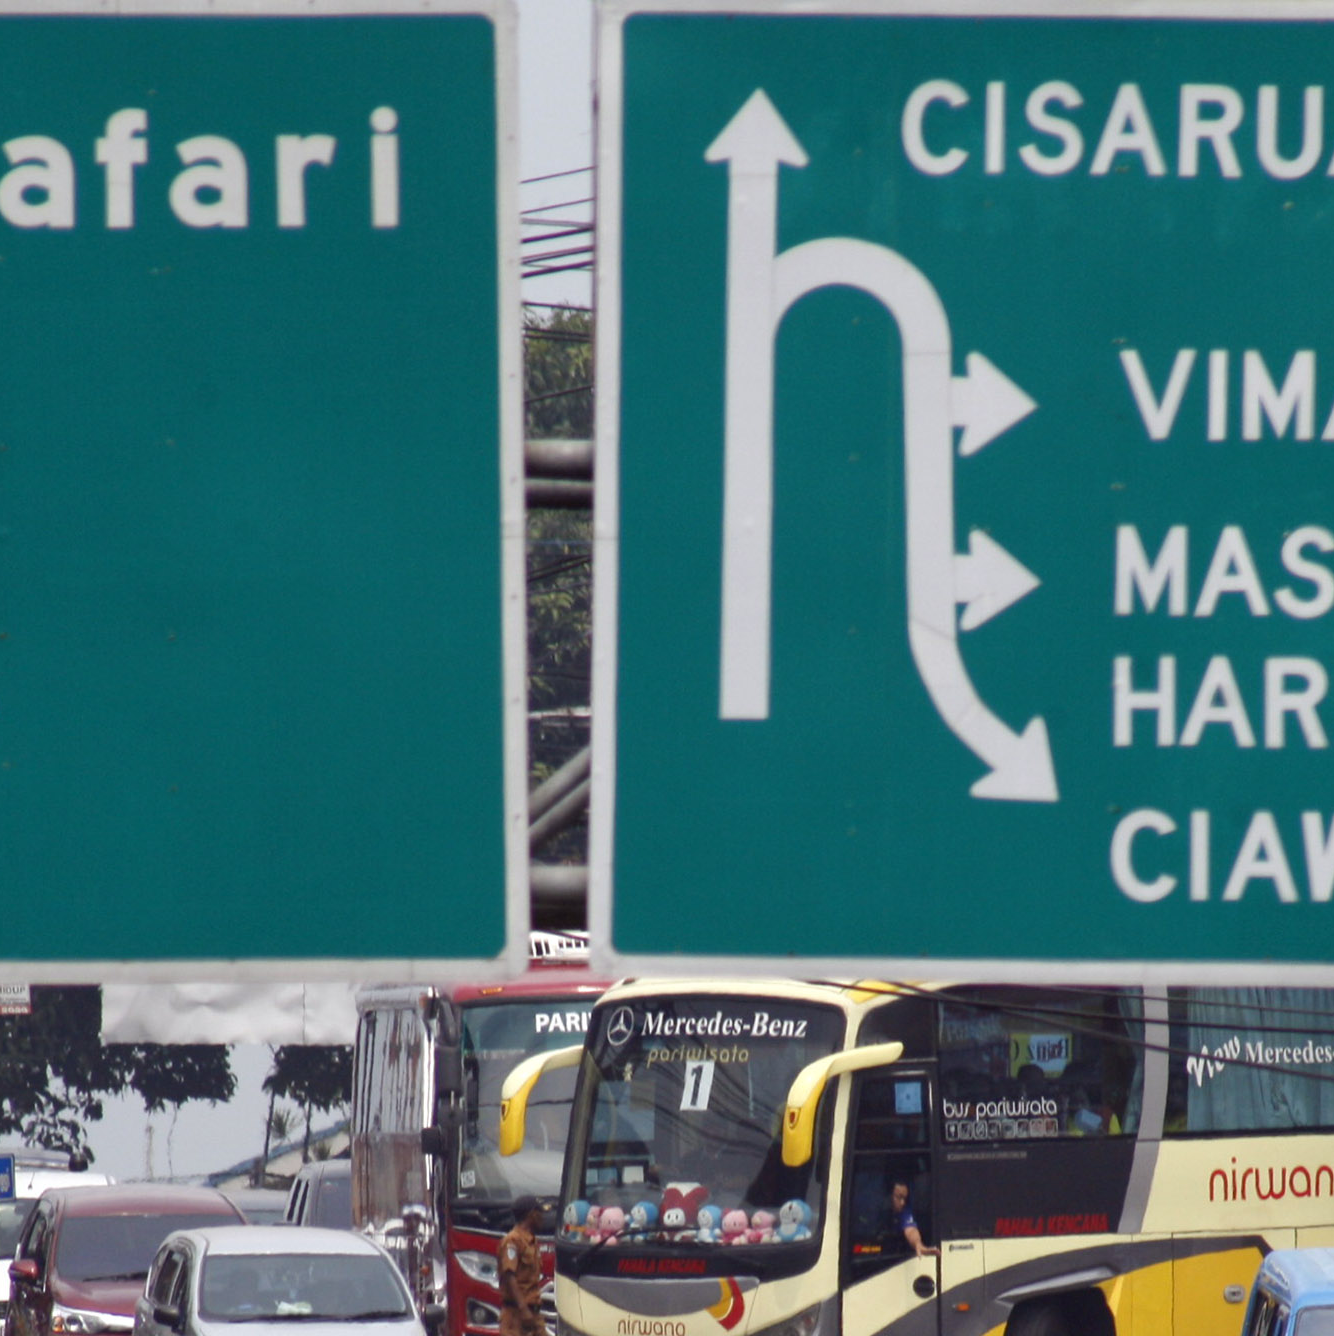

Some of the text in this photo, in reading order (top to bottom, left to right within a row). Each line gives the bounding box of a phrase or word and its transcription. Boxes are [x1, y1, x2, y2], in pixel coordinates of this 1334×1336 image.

[534, 1012, 591, 1032] PARI
[640, 1011, 808, 1038] Mercedes-Benz
[646, 1044, 749, 1069] pariwisata
[690, 1064, 704, 1107] 1
[943, 1095, 1058, 1121] bus pariwisata
